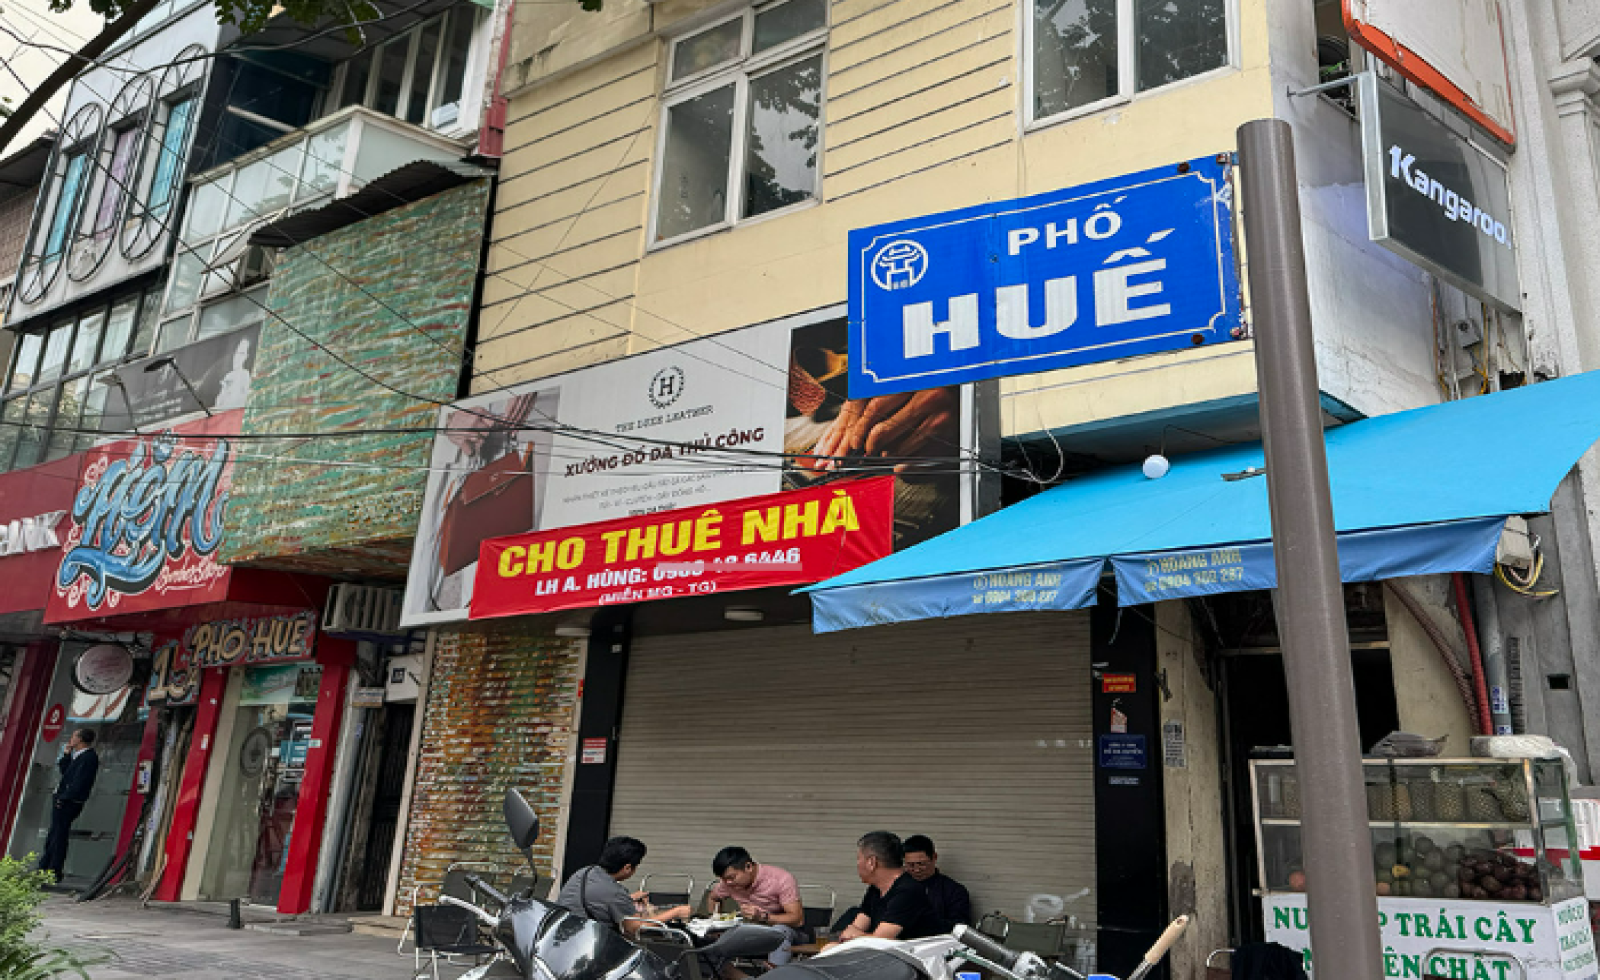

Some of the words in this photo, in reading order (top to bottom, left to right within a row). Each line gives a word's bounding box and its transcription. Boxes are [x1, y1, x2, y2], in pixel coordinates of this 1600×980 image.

[1389, 144, 1506, 245] Kangaroo
[1007, 195, 1127, 256] PHỐ
[901, 227, 1175, 360] HUẾ
[650, 446, 673, 462] DA
[715, 427, 765, 449] CÔNG
[498, 536, 586, 578] CHO
[600, 508, 723, 564] THUÊ
[740, 490, 861, 546] NHÀ
[535, 577, 558, 596] LH
[562, 575, 581, 593] A.
[585, 566, 648, 590] HÙNG:
[646, 585, 673, 598] MG
[687, 580, 717, 593] TG)
[1394, 908, 1468, 939] TRÁI
[1473, 910, 1537, 944] CÂY
